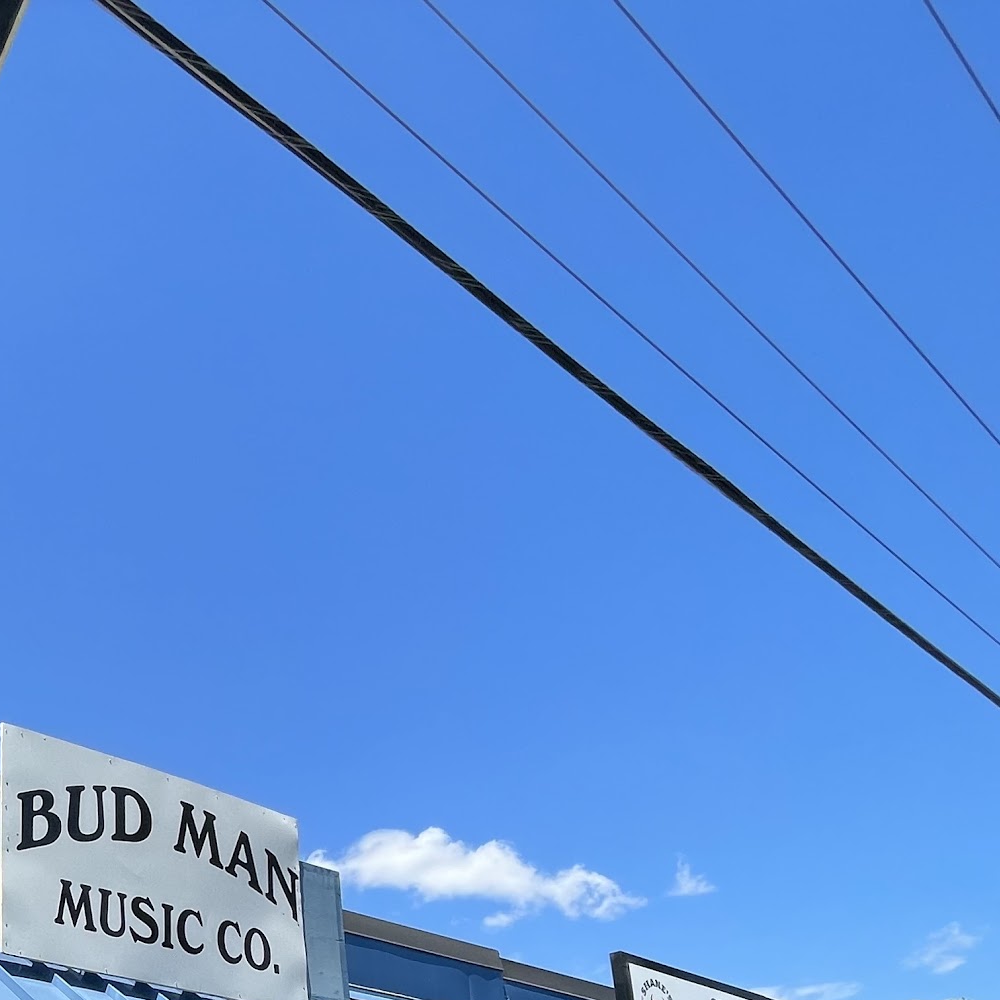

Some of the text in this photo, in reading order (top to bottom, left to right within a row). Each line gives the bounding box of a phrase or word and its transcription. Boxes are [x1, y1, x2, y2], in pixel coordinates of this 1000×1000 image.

[16, 785, 299, 922] BUD MAN
[54, 879, 280, 975] MUSIC CO.
